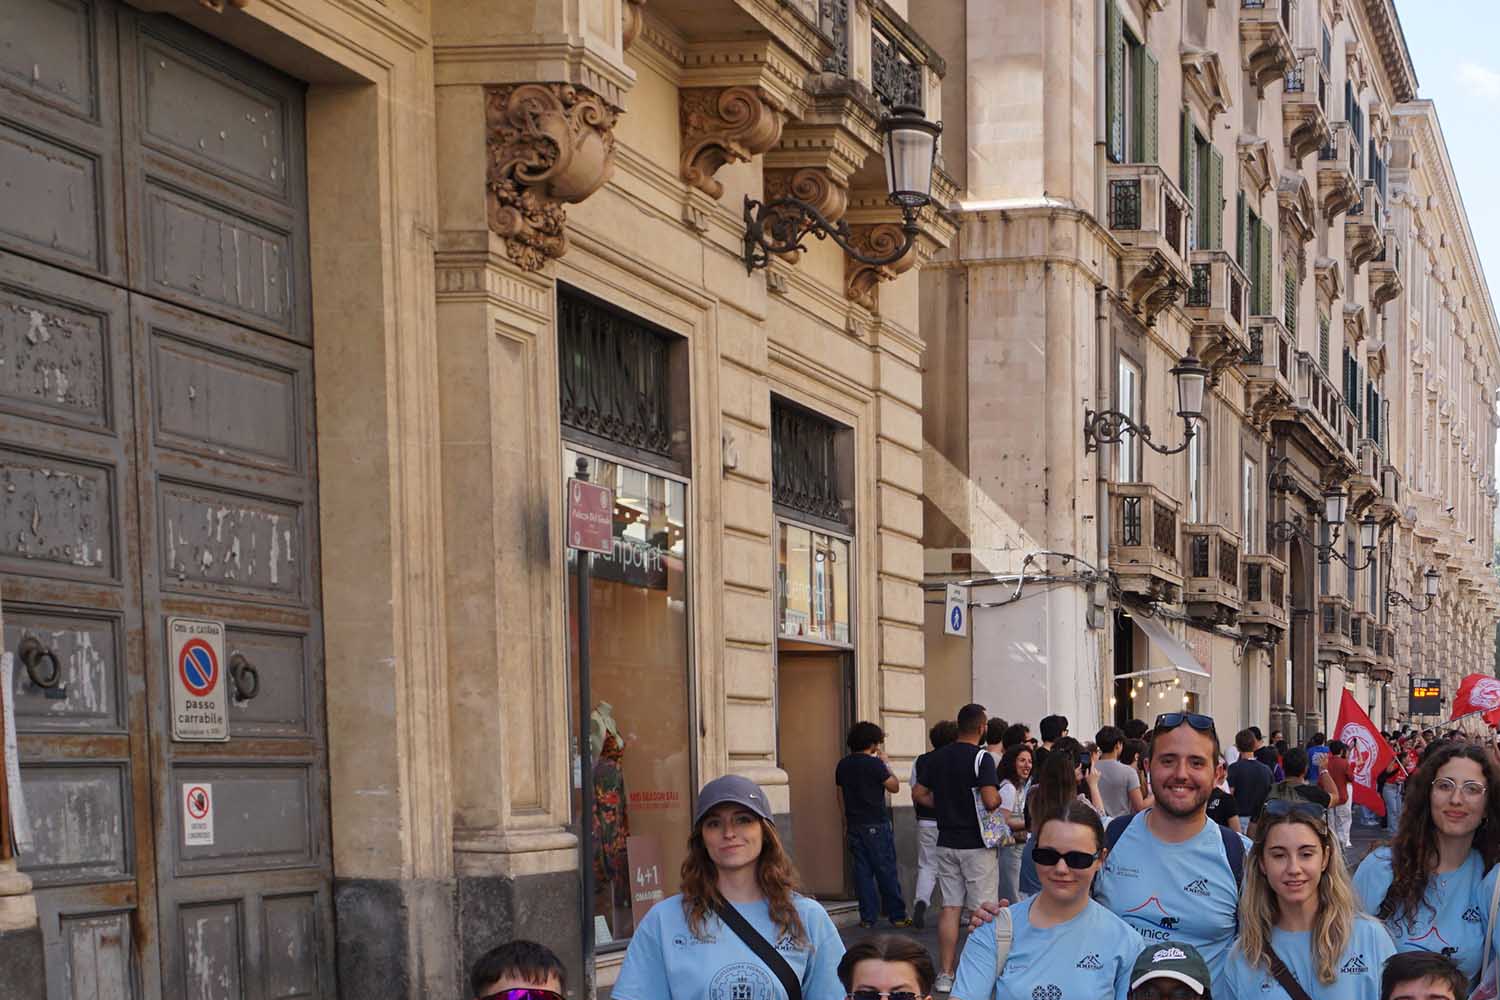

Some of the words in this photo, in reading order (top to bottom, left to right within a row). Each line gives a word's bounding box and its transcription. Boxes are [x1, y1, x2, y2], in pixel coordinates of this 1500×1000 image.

[186, 700, 215, 711] passo
[178, 713, 222, 724] carrabile
[636, 866, 658, 886] 4+1
[1130, 923, 1171, 940] unice
